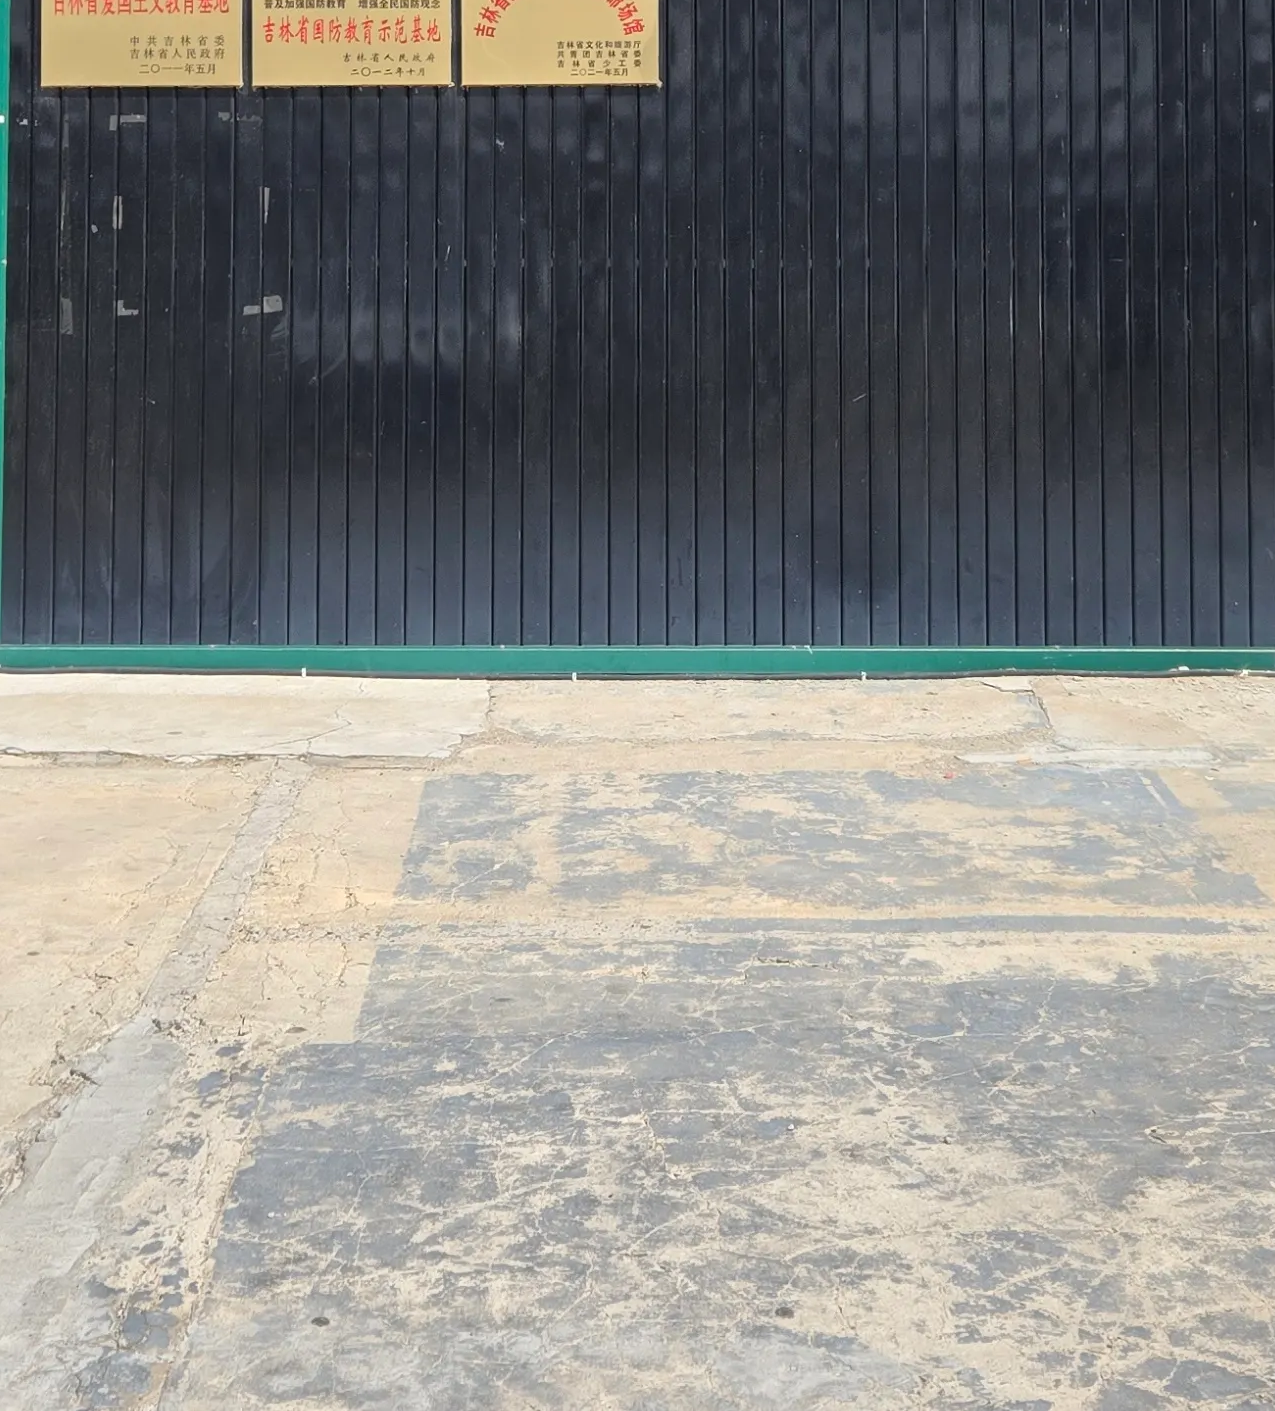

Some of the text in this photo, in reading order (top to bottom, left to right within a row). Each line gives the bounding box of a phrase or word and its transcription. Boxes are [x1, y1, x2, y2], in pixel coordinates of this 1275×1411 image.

[262, 14, 442, 45] 吉林省国防教育示范基地
[129, 35, 225, 47] 中共吉林省委
[129, 48, 225, 59] 吉林省人民政府
[342, 52, 436, 63] 吉林省人民政府
